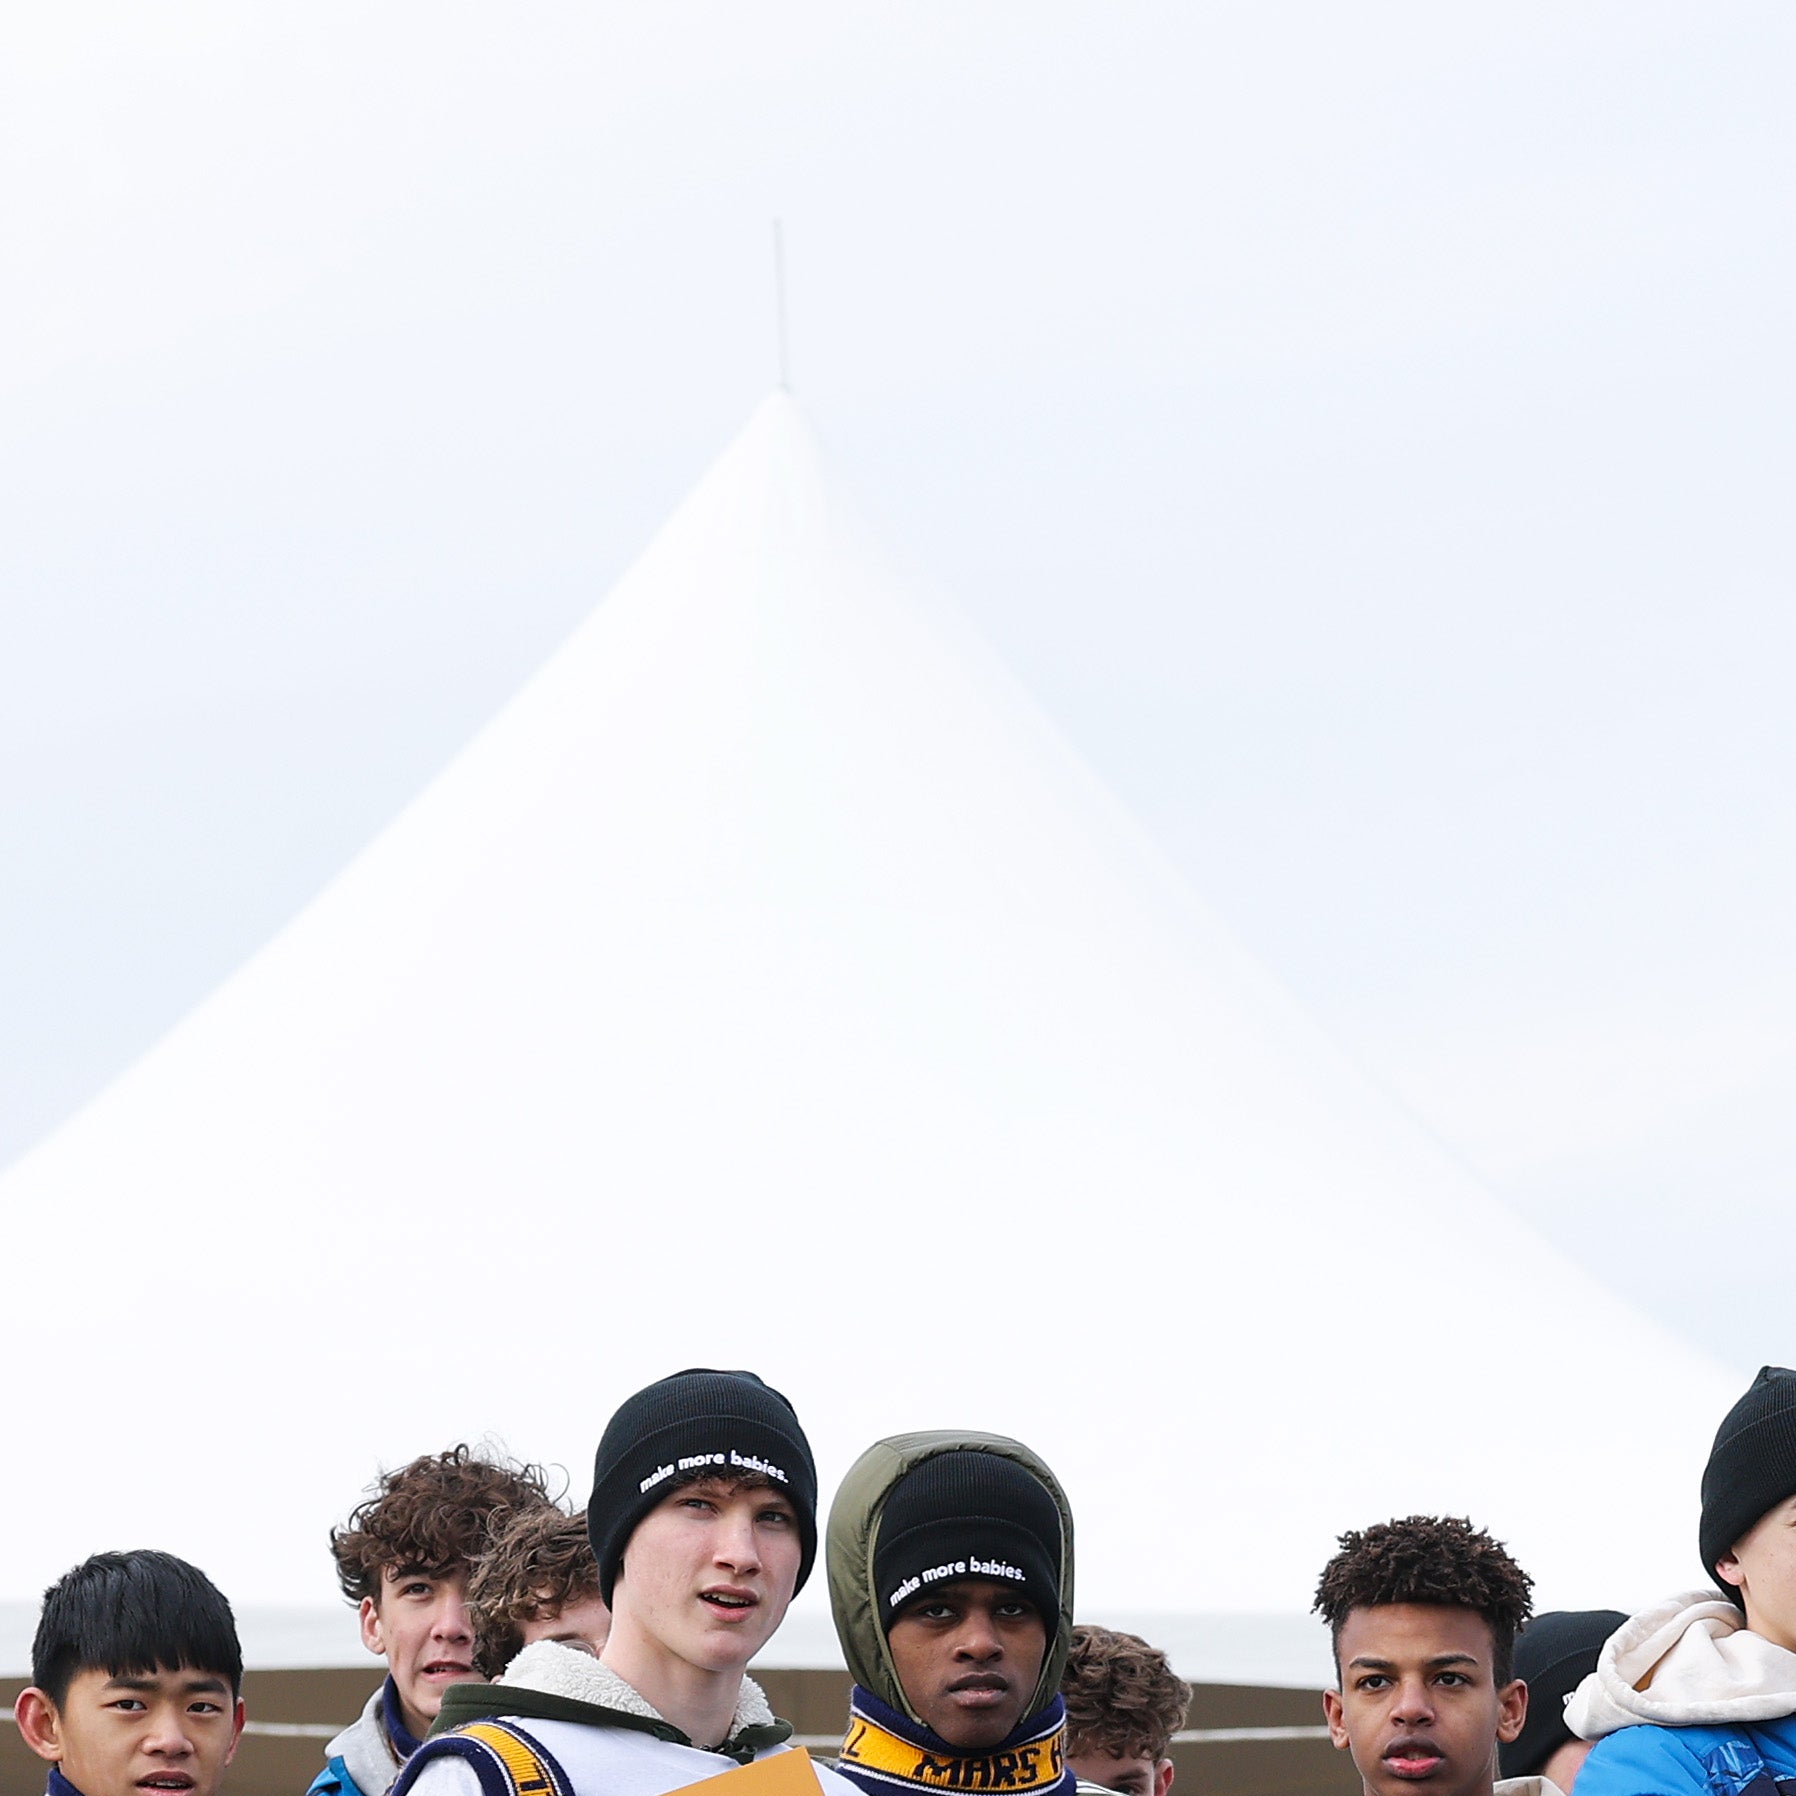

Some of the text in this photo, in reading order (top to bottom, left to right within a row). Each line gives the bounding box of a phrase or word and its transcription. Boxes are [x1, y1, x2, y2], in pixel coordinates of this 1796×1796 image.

[640, 1449, 789, 1494] make more babies.
[889, 1556, 1027, 1607] make more babies.
[914, 1747, 1042, 1788] MARS
